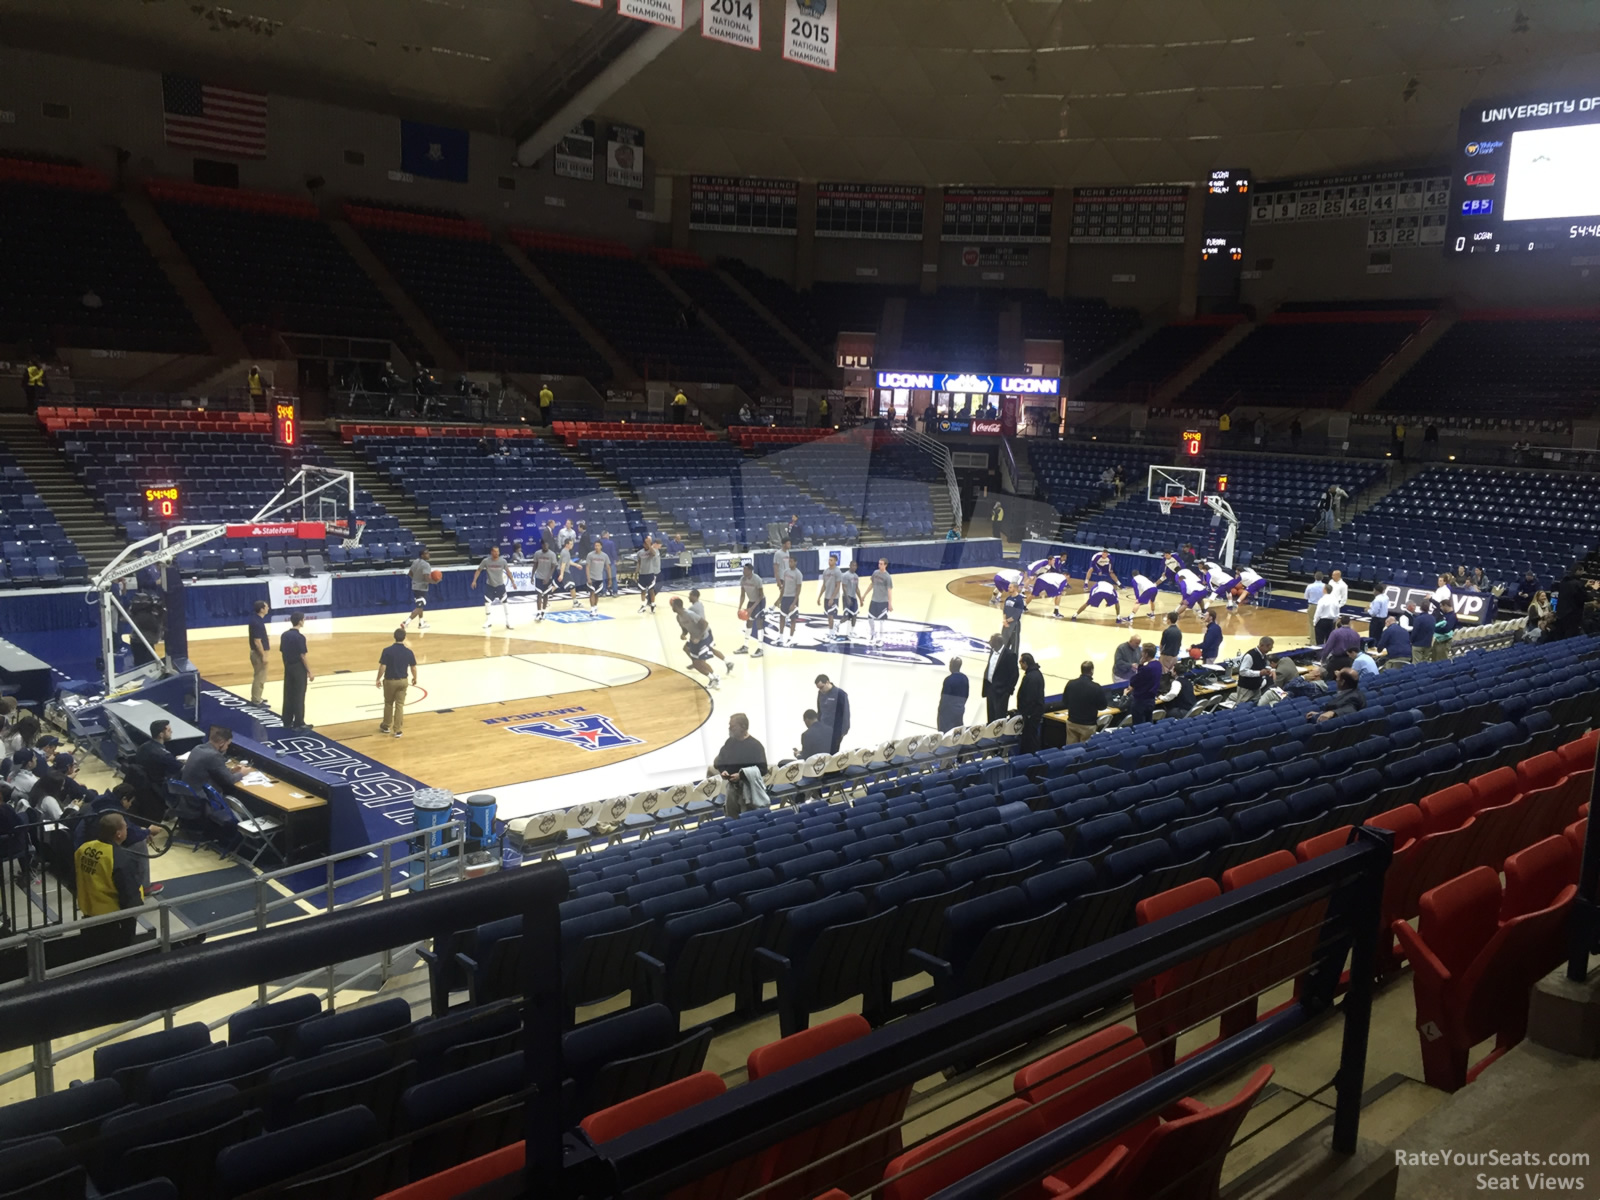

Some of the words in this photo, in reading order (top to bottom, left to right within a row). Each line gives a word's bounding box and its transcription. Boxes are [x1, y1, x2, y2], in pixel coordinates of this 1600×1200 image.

[626, 4, 676, 25] CHAMPIONS
[710, 0, 754, 20] 2014
[712, 16, 751, 32] NATIONAL
[709, 26, 754, 45] CHAMPIONS
[790, 18, 830, 44] 2015
[792, 39, 828, 56] NATIONAL
[789, 49, 830, 68] CHAMPIONS
[1481, 99, 1575, 123] UNIVERSITY
[1579, 97, 1600, 111] OF
[739, 179, 796, 188] CONFERENCE
[865, 186, 923, 194] CONFERENCE
[1349, 199, 1367, 211] 42
[1374, 197, 1392, 209] 44
[1427, 193, 1447, 204] 42
[1282, 206, 1289, 217] 9
[1300, 203, 1317, 215] 22
[1324, 201, 1341, 213] 25
[1373, 231, 1386, 242] 13
[1397, 230, 1415, 241] 22
[1455, 237, 1465, 251] 0
[1528, 242, 1534, 250] 0
[878, 372, 934, 388] UCONN
[1001, 378, 1058, 394] UCONN
[277, 404, 293, 420] 54:48
[285, 420, 292, 443] 0
[1183, 432, 1201, 440] 54:48
[1191, 441, 1198, 454] 0
[146, 488, 177, 501] 54:48
[162, 501, 171, 515] 0
[103, 552, 168, 582] UCONNHUSKIES.COM
[284, 585, 317, 595] BOB'S
[84, 847, 103, 860] CSC
[81, 856, 98, 867] EVENT
